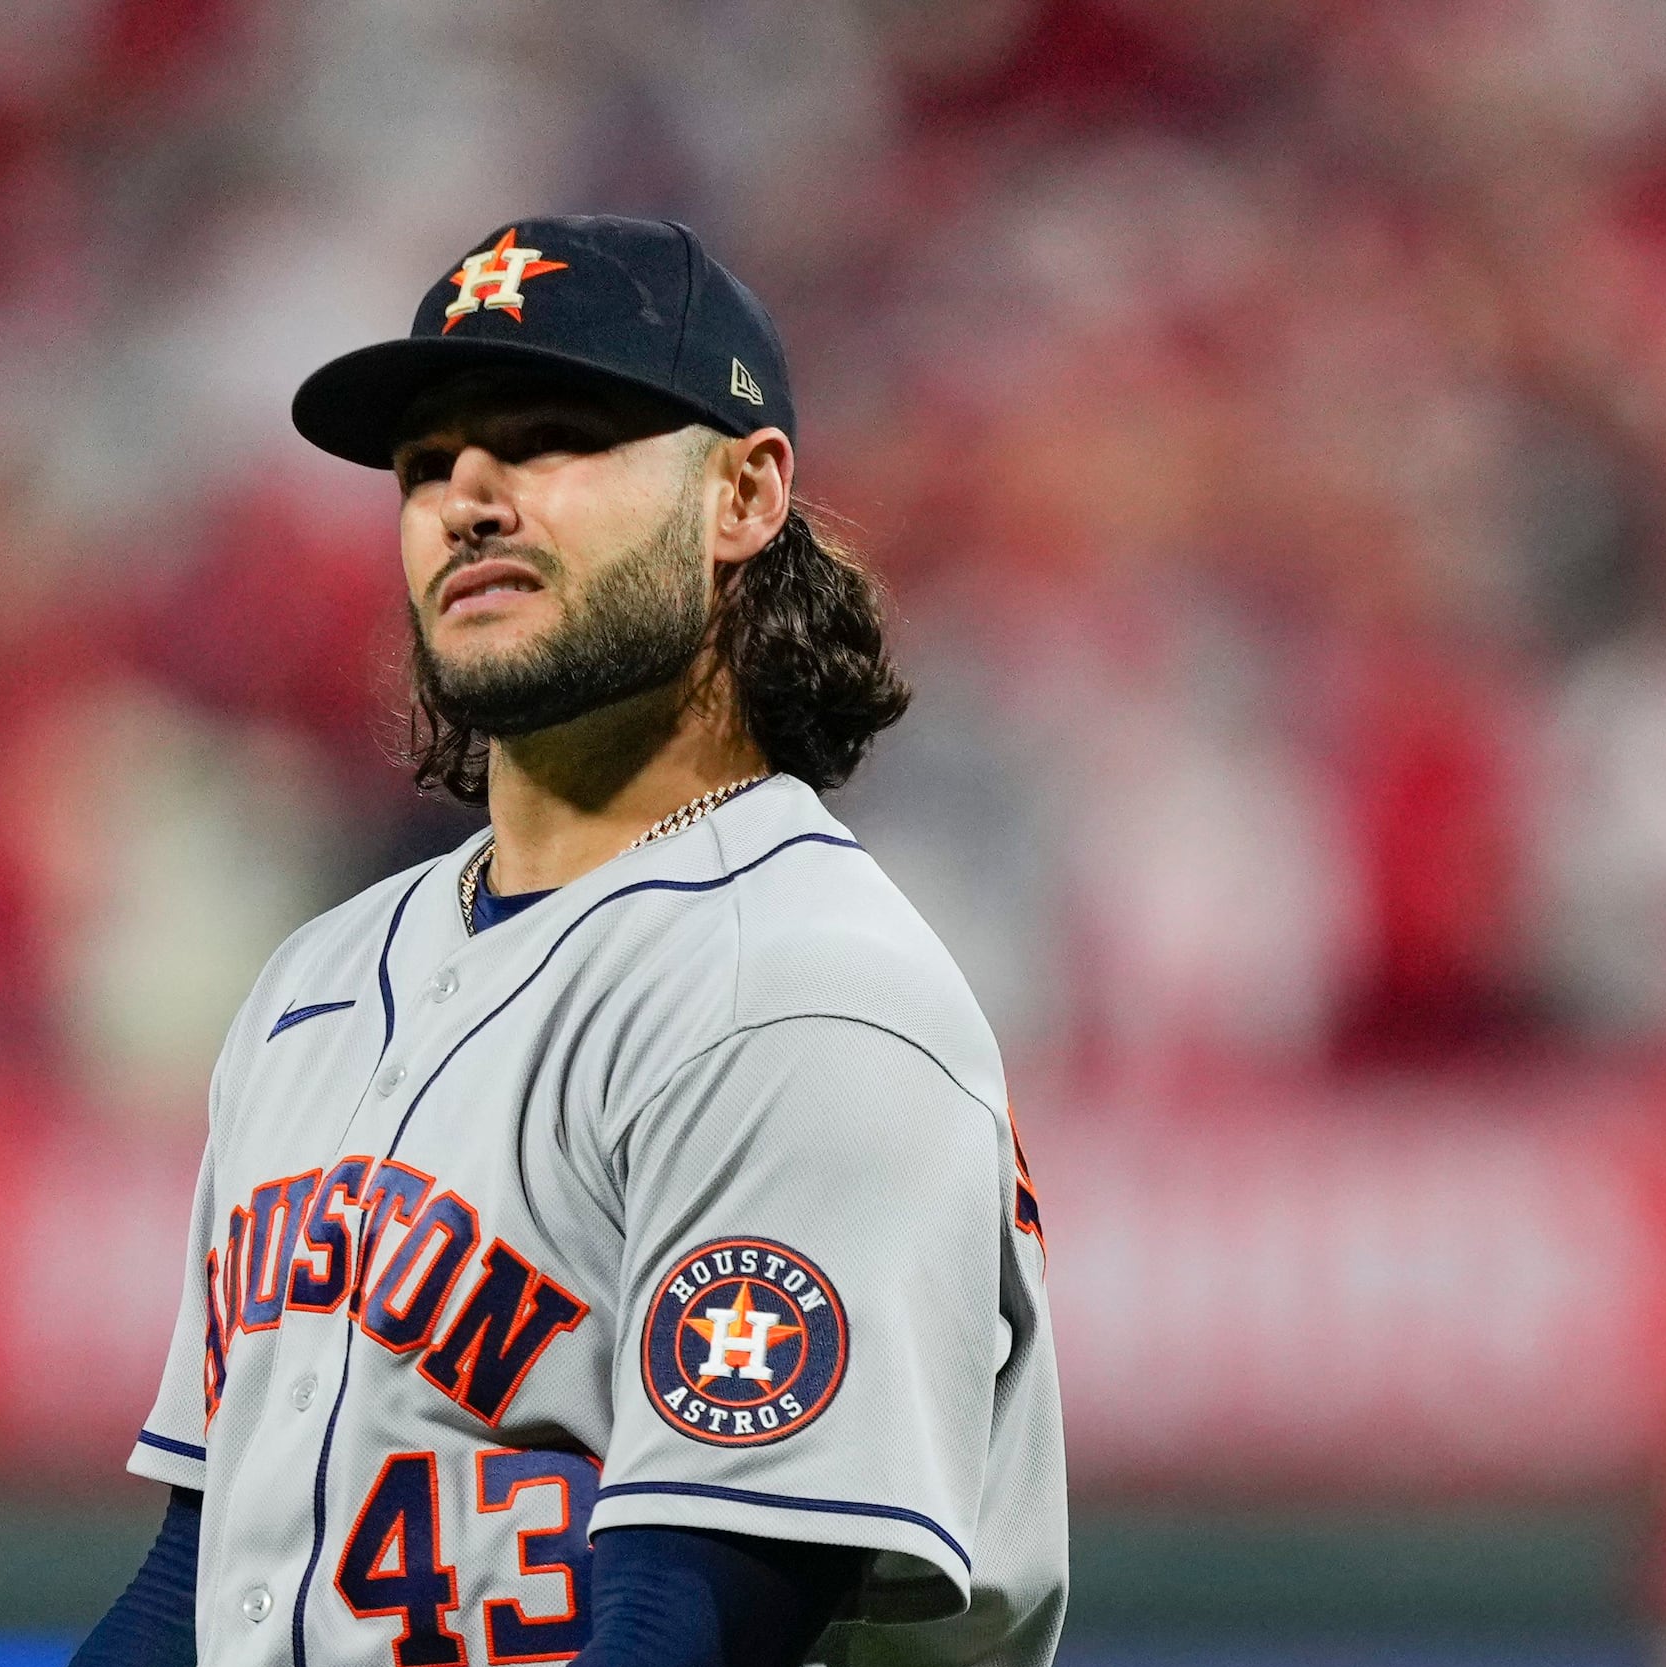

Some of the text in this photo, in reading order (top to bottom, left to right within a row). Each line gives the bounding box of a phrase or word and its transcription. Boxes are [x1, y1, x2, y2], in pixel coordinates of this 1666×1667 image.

[444, 247, 543, 319] H
[667, 1249, 828, 1313] HOUSTON
[699, 1307, 781, 1381] H
[663, 1385, 804, 1435] ASTROS
